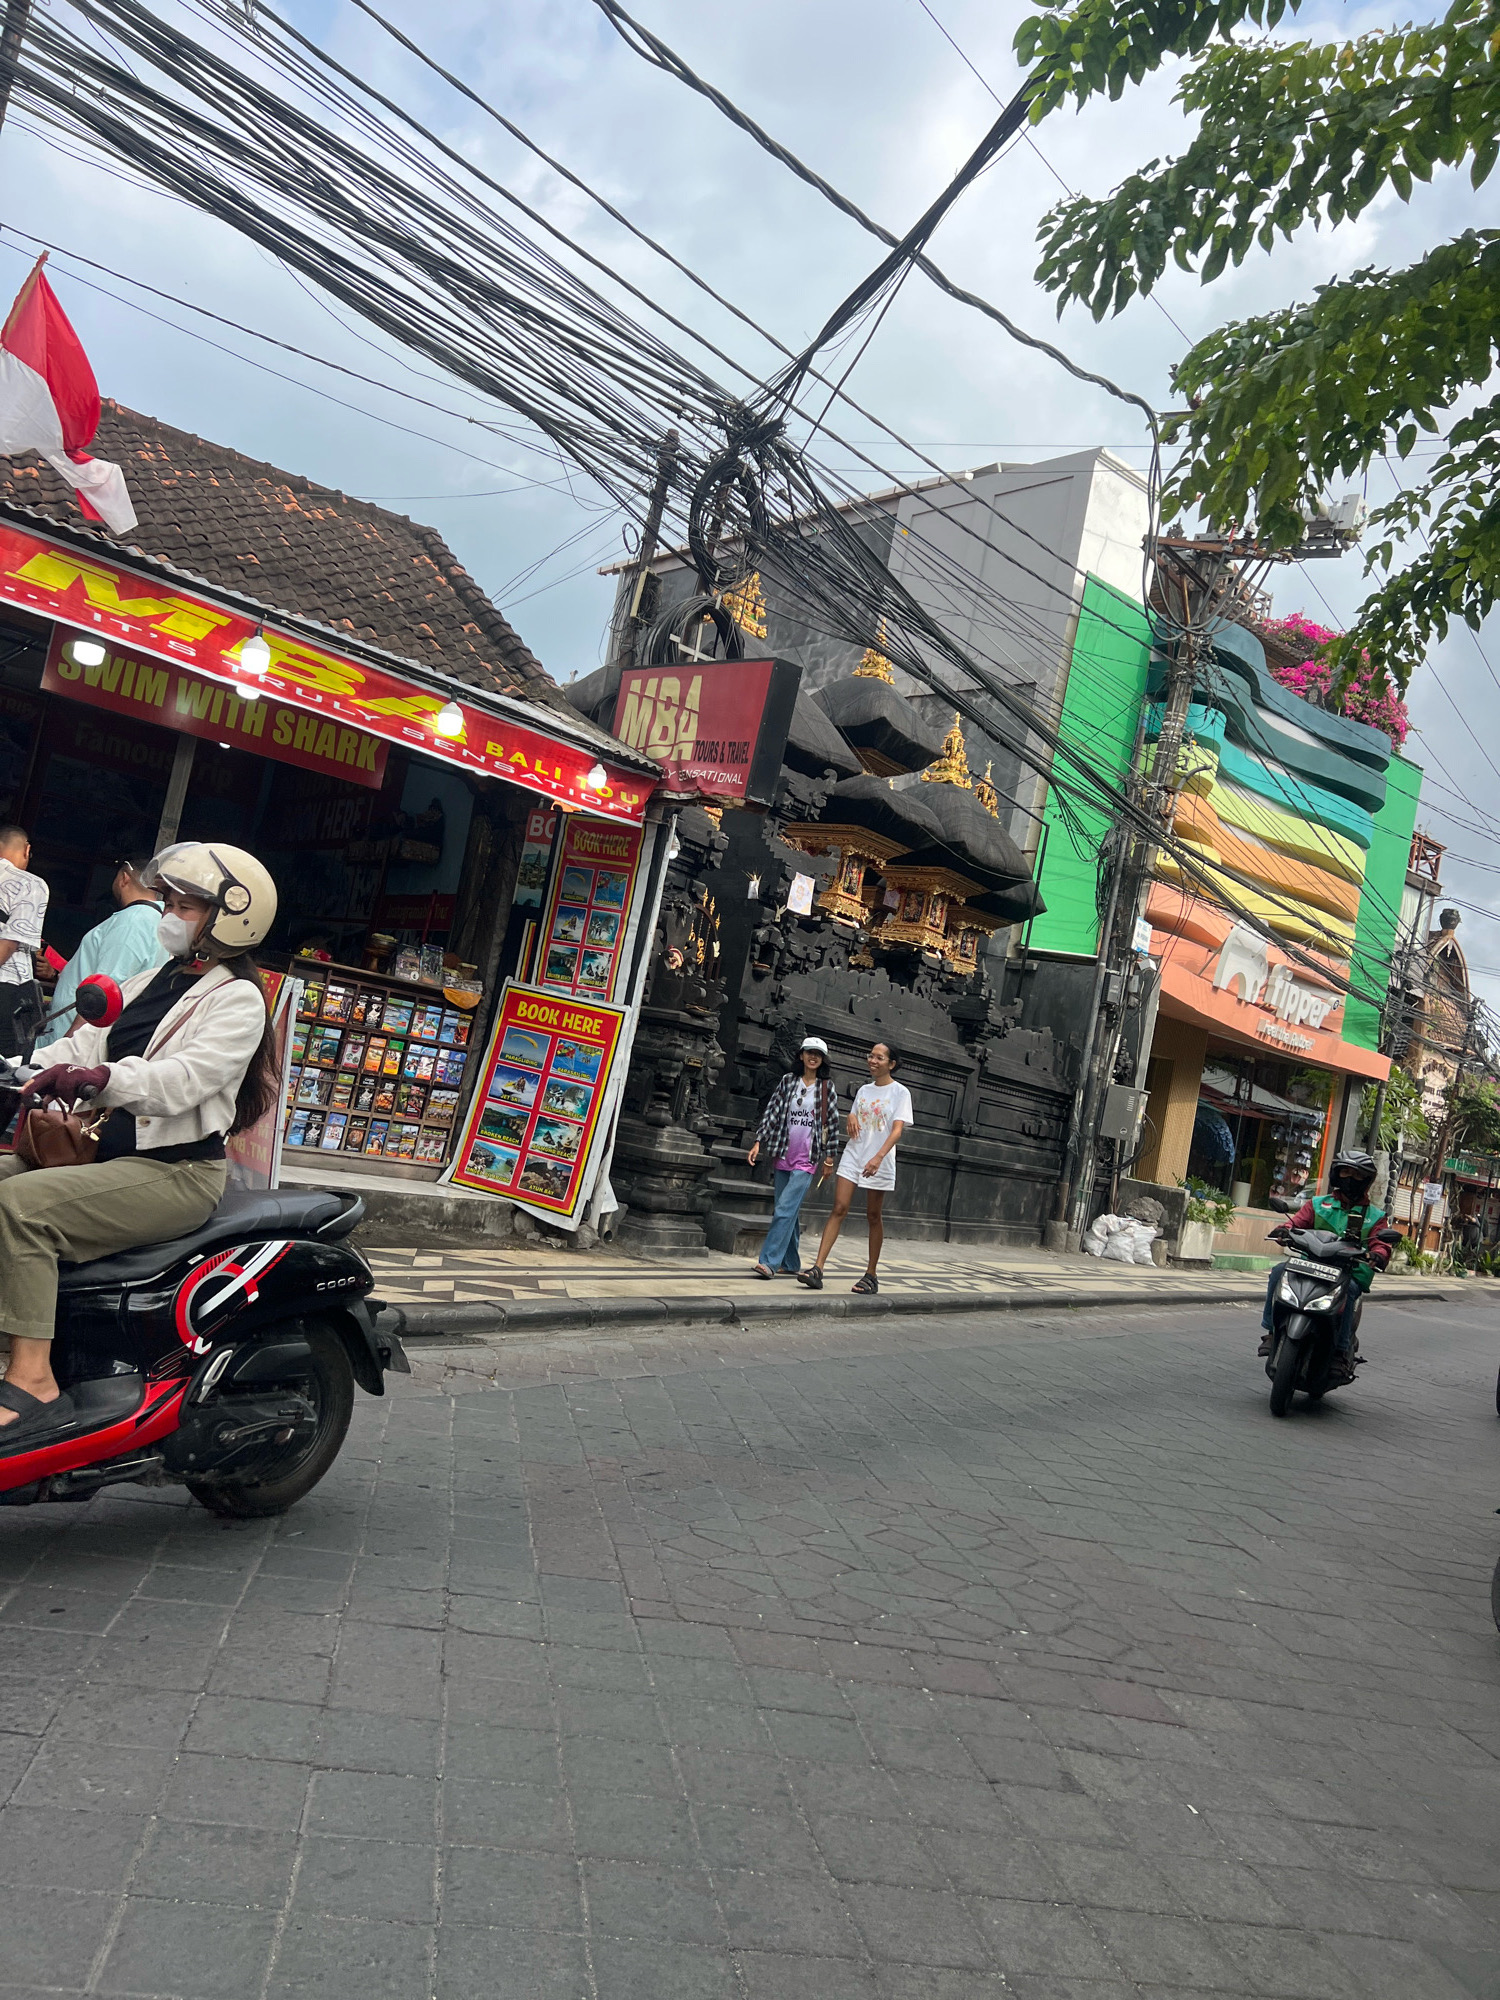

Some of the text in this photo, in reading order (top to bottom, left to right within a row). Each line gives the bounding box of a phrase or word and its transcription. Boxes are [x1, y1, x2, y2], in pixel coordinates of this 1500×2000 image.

[4, 550, 468, 745] MBA
[93, 612, 197, 657] IT'S
[221, 659, 382, 721] TRULY
[57, 640, 383, 772] SWIM WITH SHARK
[618, 674, 703, 762] MBA
[485, 740, 562, 781] BALI
[693, 740, 750, 765] TOURS & TRAVEL
[678, 768, 743, 785] SENSATIONAL
[573, 829, 632, 857] BOOK HERE
[516, 1000, 604, 1036] BOOK HERE
[504, 1053, 539, 1067] PARAGLIDING
[480, 1129, 520, 1144] BROKEN BEACH
[557, 1150, 576, 1160] BEACH
